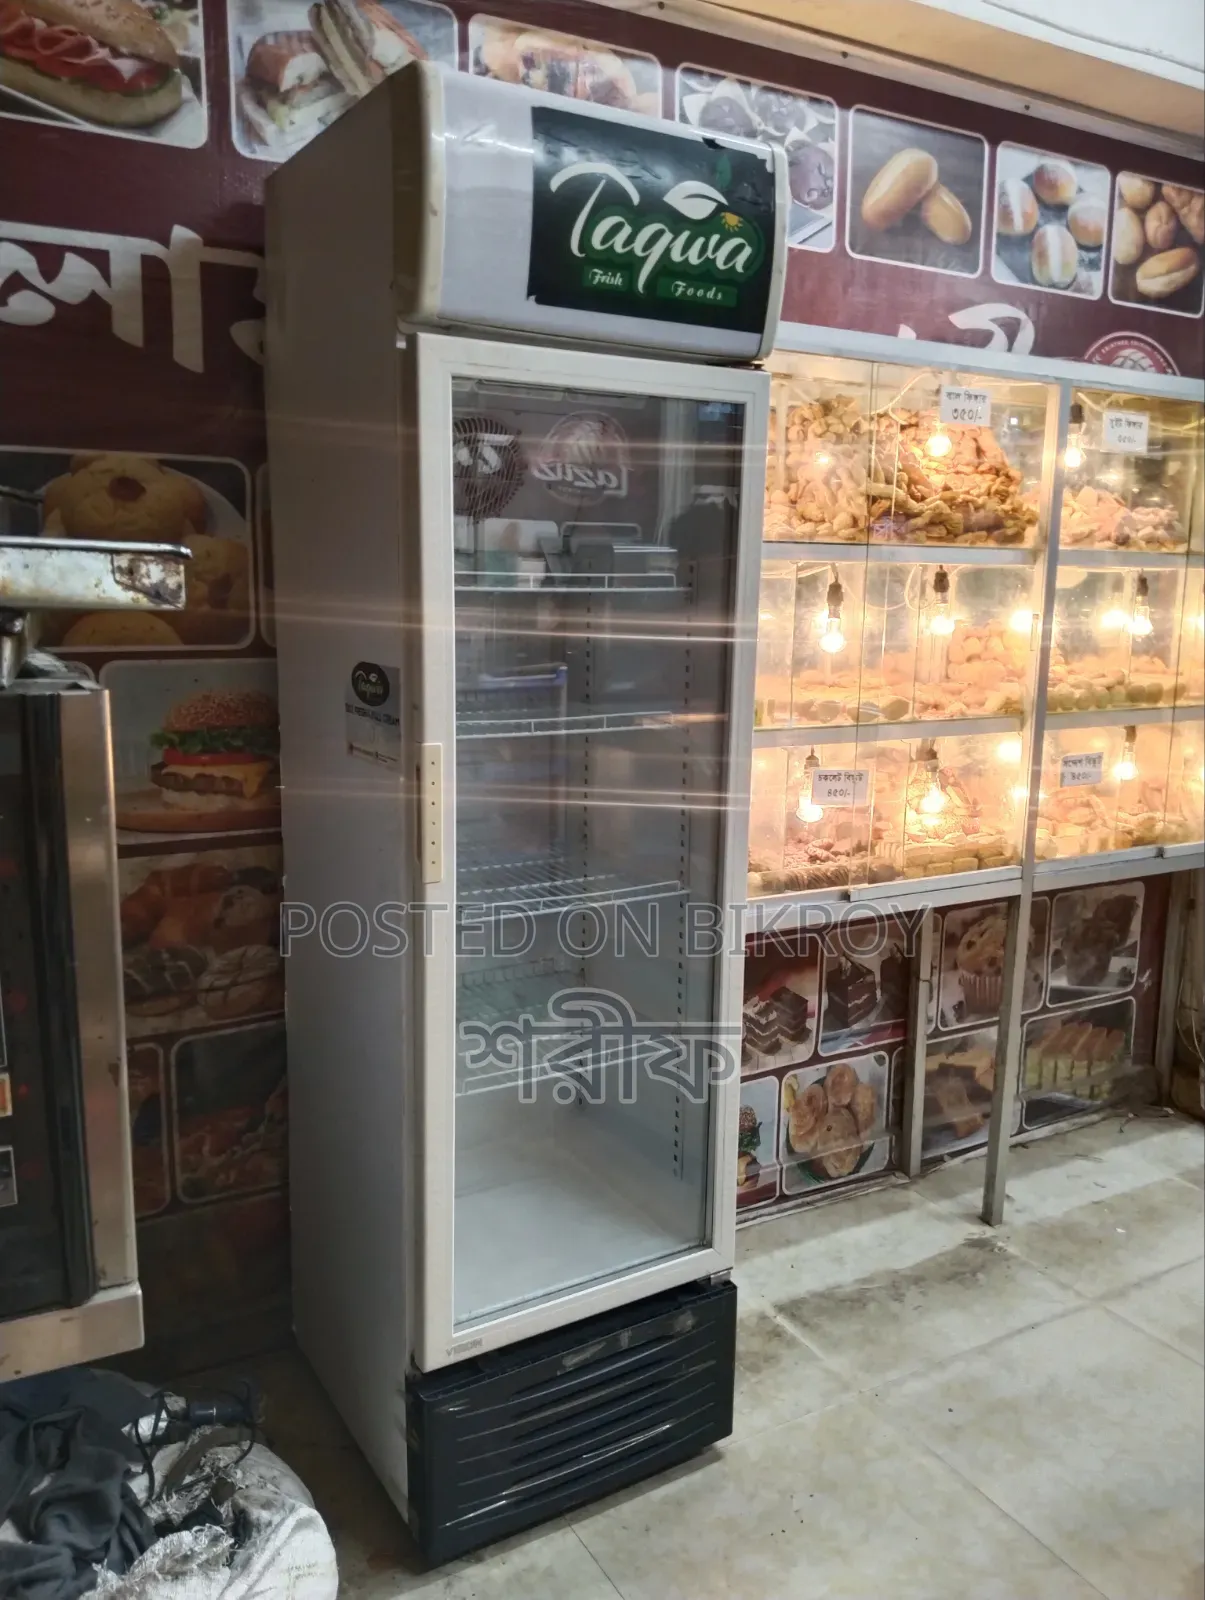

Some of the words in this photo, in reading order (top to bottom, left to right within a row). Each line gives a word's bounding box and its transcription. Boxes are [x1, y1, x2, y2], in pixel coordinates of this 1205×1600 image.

[550, 162, 752, 294] Taqwa
[671, 280, 723, 301] Foods
[827, 788, 850, 798] ৪৫০/-
